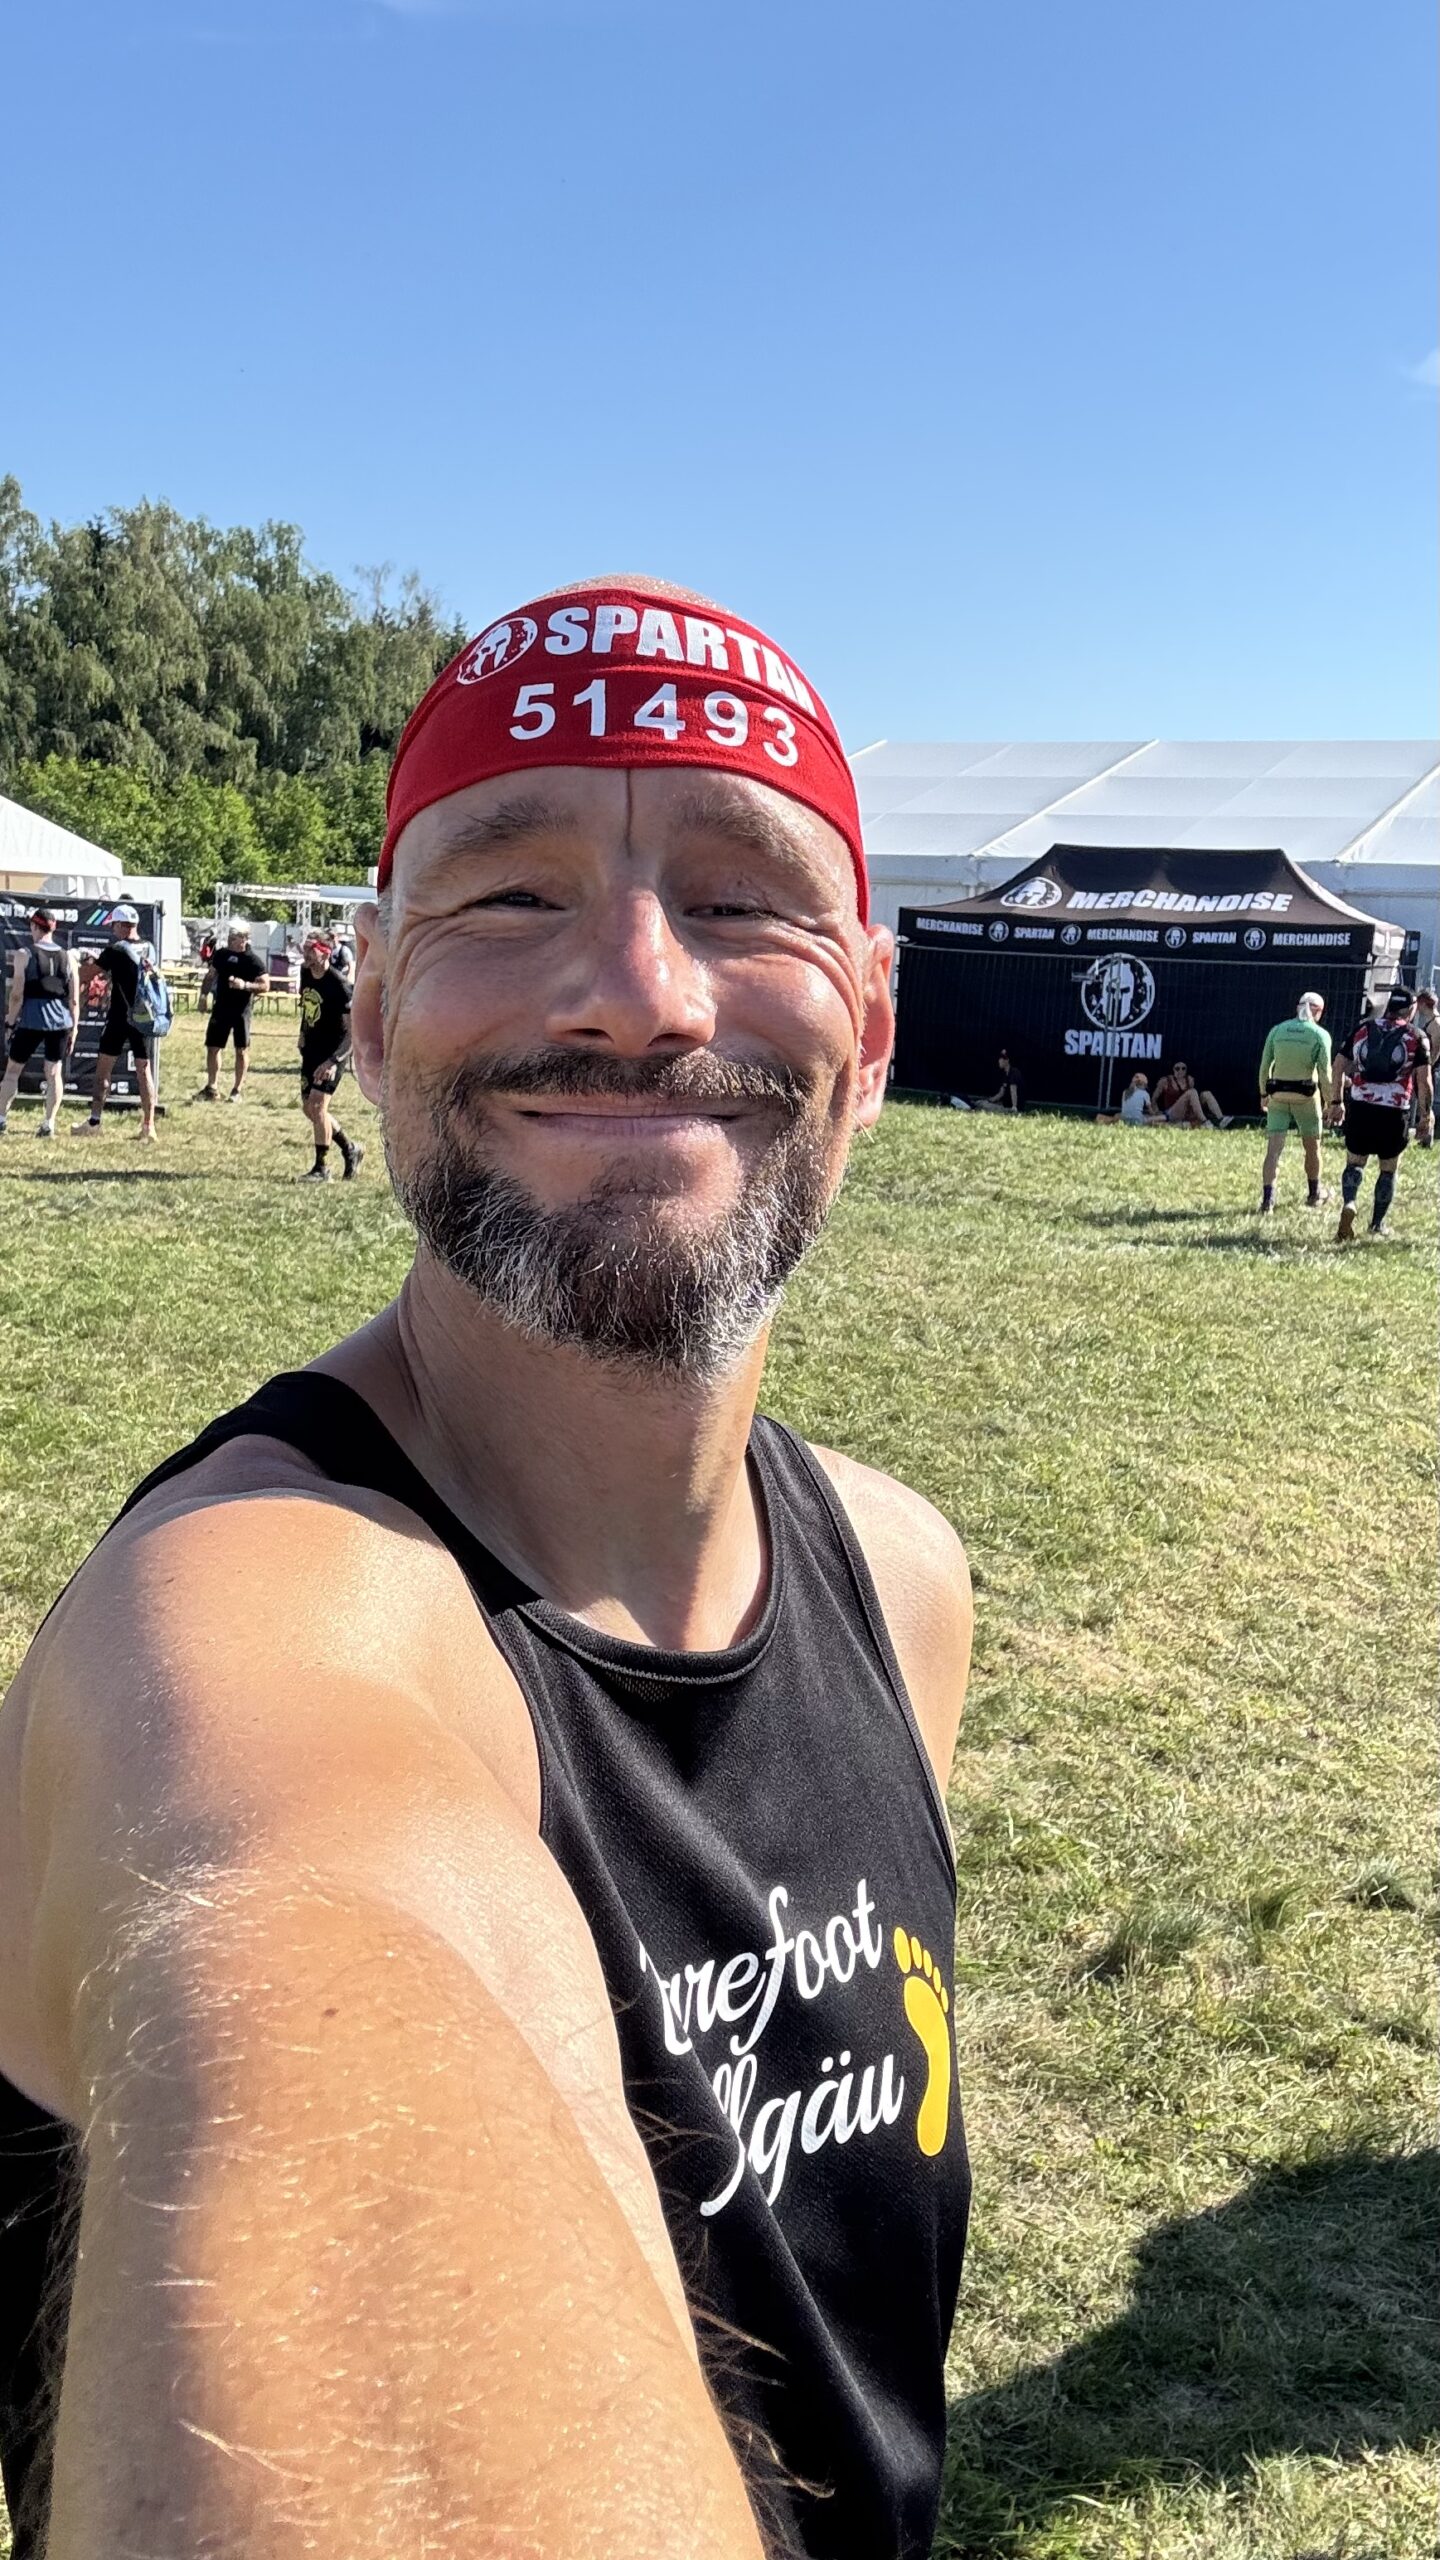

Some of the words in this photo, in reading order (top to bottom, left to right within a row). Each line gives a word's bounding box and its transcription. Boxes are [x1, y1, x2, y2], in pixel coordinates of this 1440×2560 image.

[544, 606, 818, 718] SPARTAN
[509, 679, 799, 767] 51493
[1066, 889, 1293, 912] MERCHANDISE
[916, 917, 984, 936] MERCHANDISE
[1014, 926, 1055, 940] SPARTAN
[1086, 928, 1159, 943] MERCHANDISE
[1192, 931, 1237, 945] SPARTAN
[1272, 932, 1351, 946] MERCHANDISE
[1064, 1028, 1162, 1059] SPARTAN
